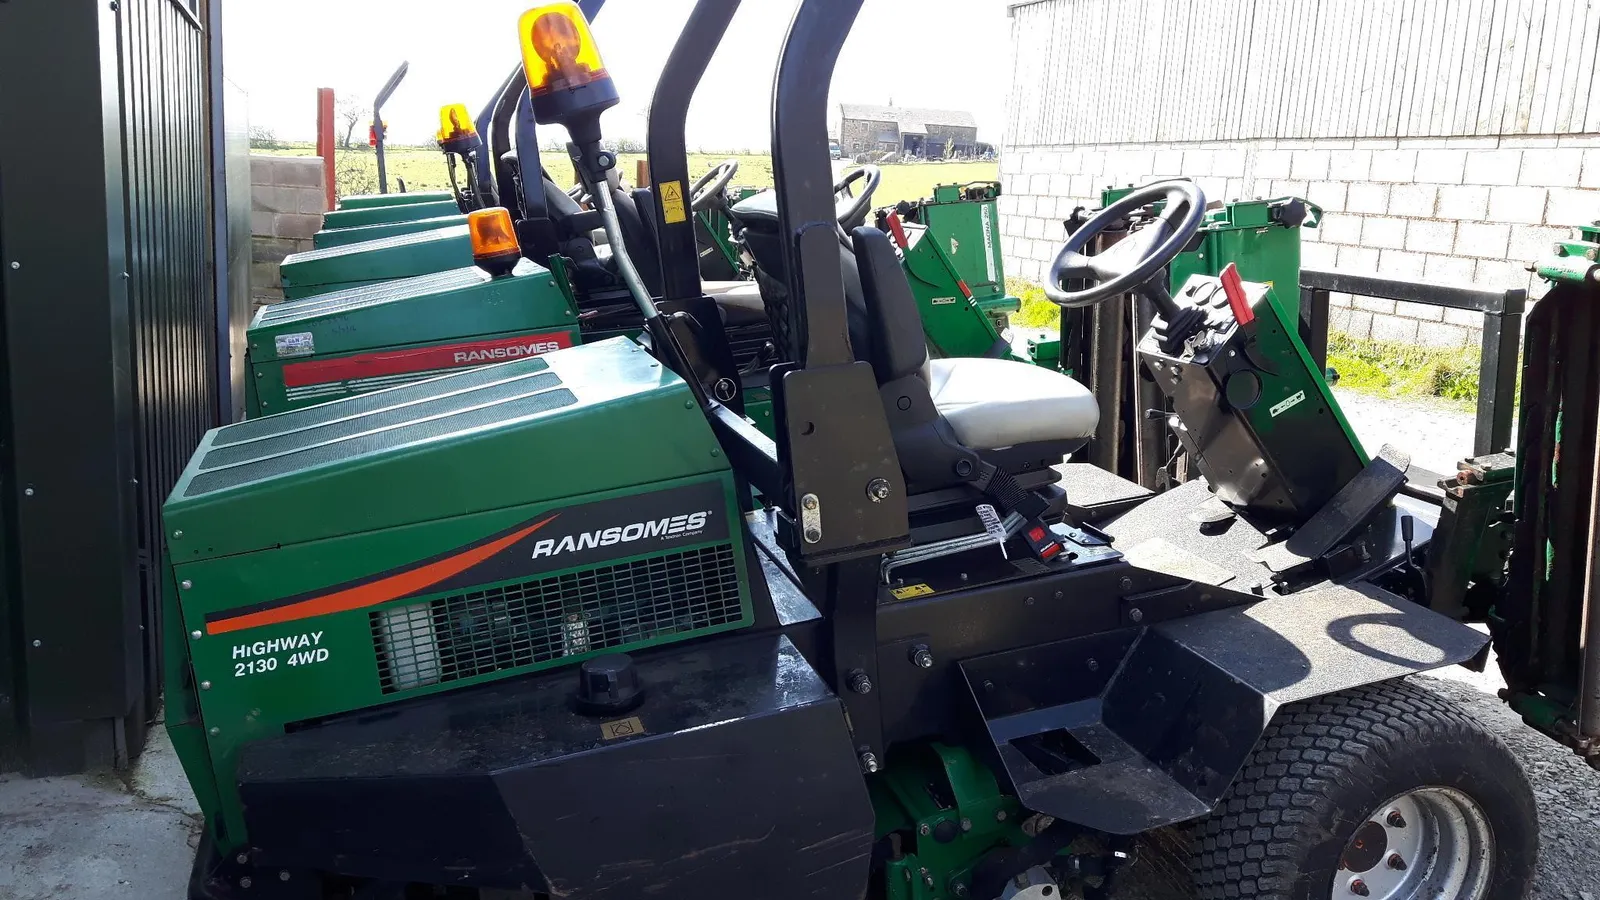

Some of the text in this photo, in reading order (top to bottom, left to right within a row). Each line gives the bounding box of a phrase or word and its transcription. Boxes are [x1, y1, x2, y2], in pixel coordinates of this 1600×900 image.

[453, 341, 560, 363] RANSOMES
[234, 648, 329, 677] 2130 4WD
